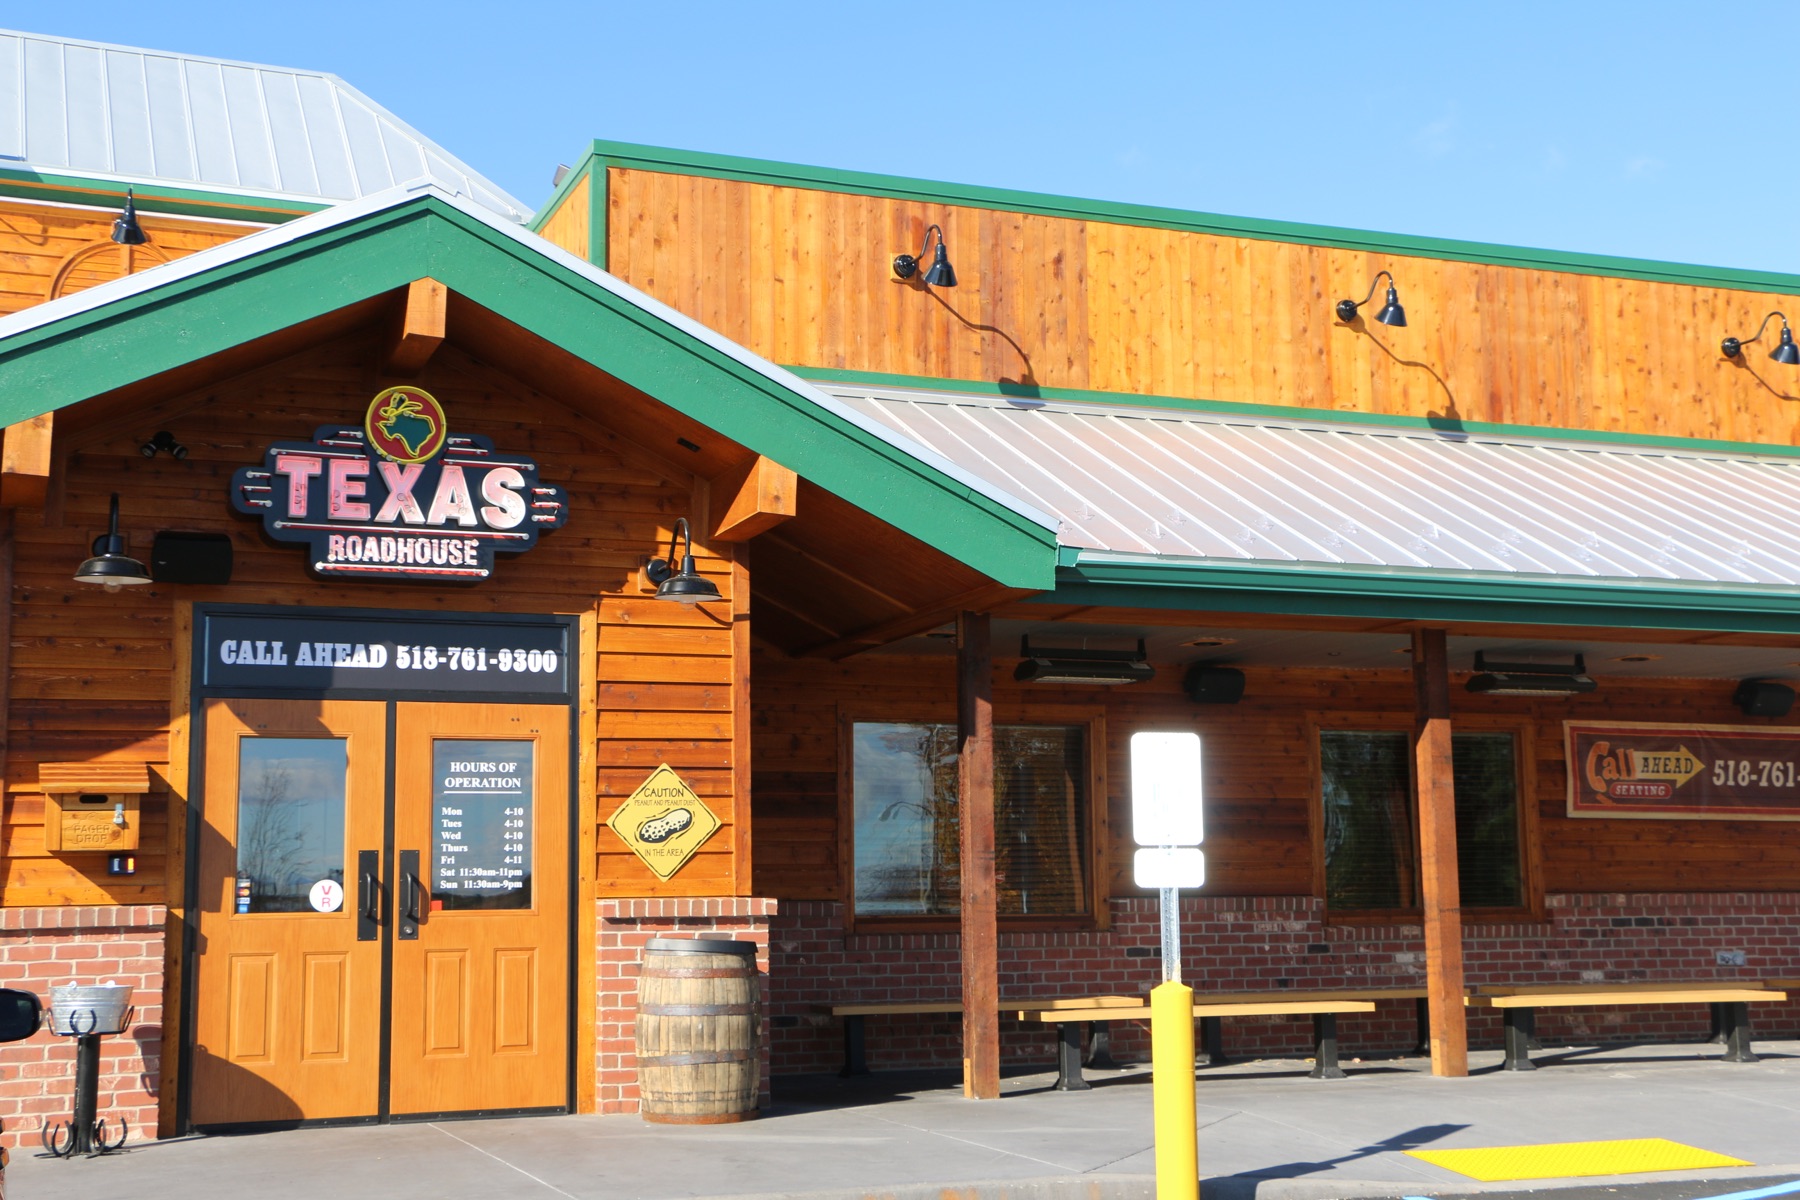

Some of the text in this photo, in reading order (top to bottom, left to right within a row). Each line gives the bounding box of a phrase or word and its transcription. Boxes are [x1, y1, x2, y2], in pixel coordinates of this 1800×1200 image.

[275, 455, 526, 530] TEXAS
[327, 534, 480, 566] ROADHOUSE
[220, 639, 558, 673] CALL AHEAD 518-761-9300
[450, 762, 518, 773] HOURS OF
[1585, 741, 1638, 793] Call
[1641, 756, 1694, 774] AHEAD
[444, 777, 522, 788] OPERATION
[643, 787, 685, 798] CAUTION
[1614, 784, 1666, 796] SEATING
[441, 807, 524, 816] Mon 4-10
[73, 824, 110, 834] PAGER
[441, 819, 524, 828] Tues 4-10
[75, 834, 108, 843] DROP
[441, 831, 523, 840] Wed 4-10
[441, 843, 523, 852] Thurs 4-10
[644, 848, 685, 857] IN THE AREA
[440, 855, 522, 865] Fri 4-11
[440, 867, 523, 878] Sat 11:30am-11pm
[440, 880, 523, 891] Sun 11:30am-9pm
